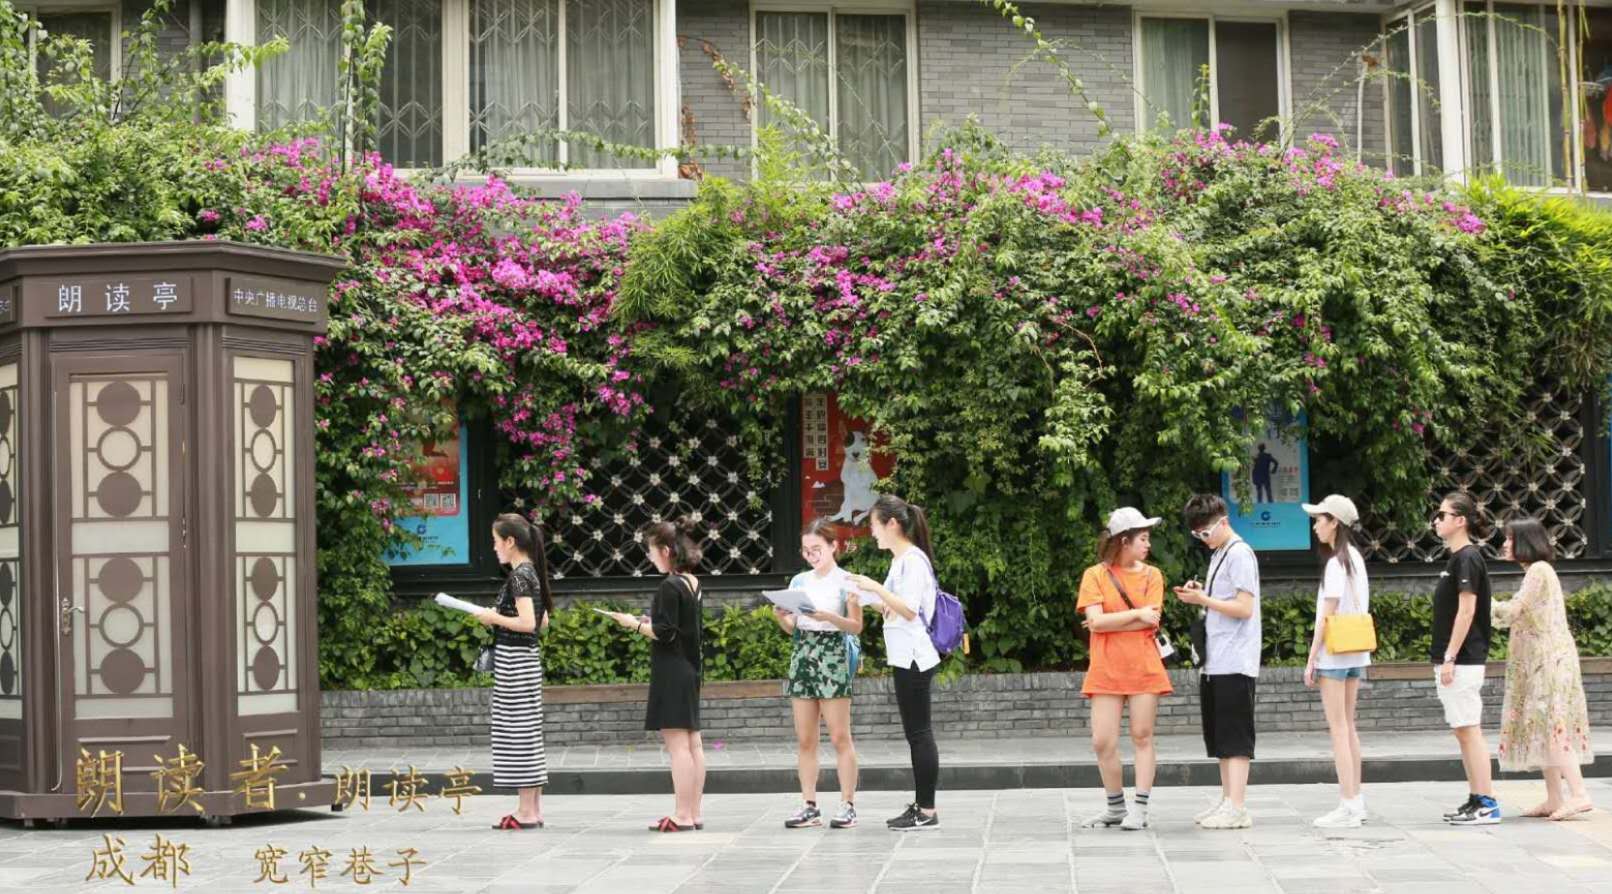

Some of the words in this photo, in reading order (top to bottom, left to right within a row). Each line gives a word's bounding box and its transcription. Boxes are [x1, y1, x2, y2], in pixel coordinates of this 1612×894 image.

[58, 281, 178, 313] 朗读亭
[233, 287, 318, 313] 中央广播电视总台
